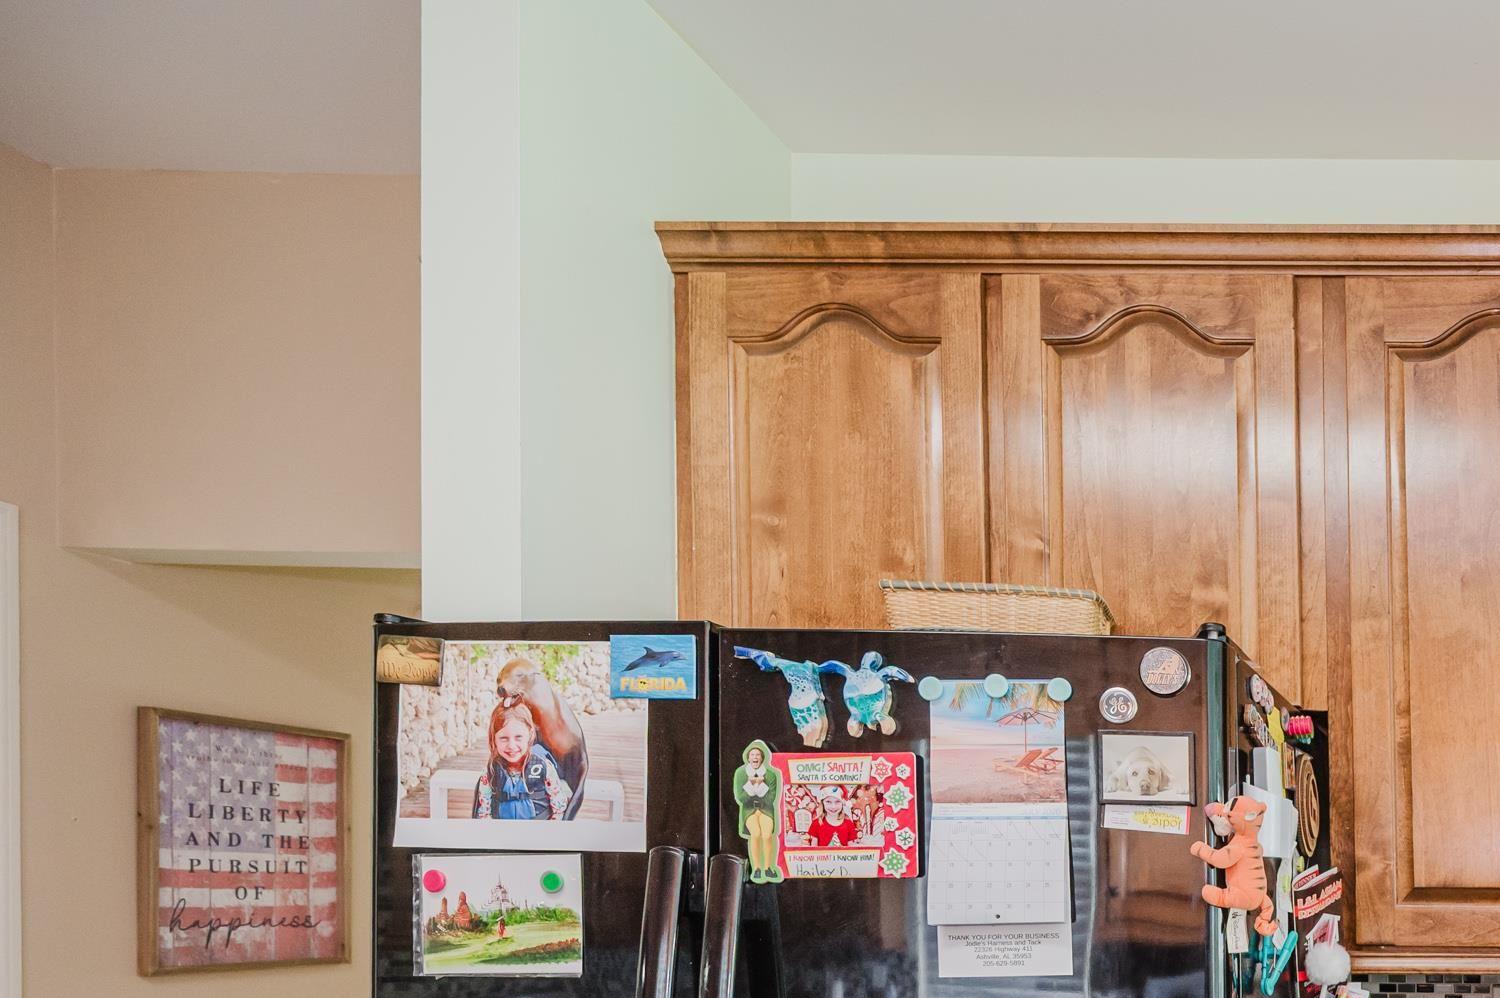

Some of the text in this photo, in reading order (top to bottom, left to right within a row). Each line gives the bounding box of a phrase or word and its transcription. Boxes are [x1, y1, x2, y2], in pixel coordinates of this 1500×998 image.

[620, 675, 688, 692] FLORIDA
[796, 761, 864, 773] OMG! SANTA!
[829, 773, 862, 781] COMING!
[219, 778, 281, 797] LIFE
[188, 802, 308, 824] LIBERTY
[185, 831, 310, 850] AND THE
[860, 853, 875, 861] HIM!
[188, 858, 308, 875] PURSUIT
[796, 863, 835, 877] Hailey
[234, 886, 265, 900] OF
[169, 898, 321, 950] happiness
